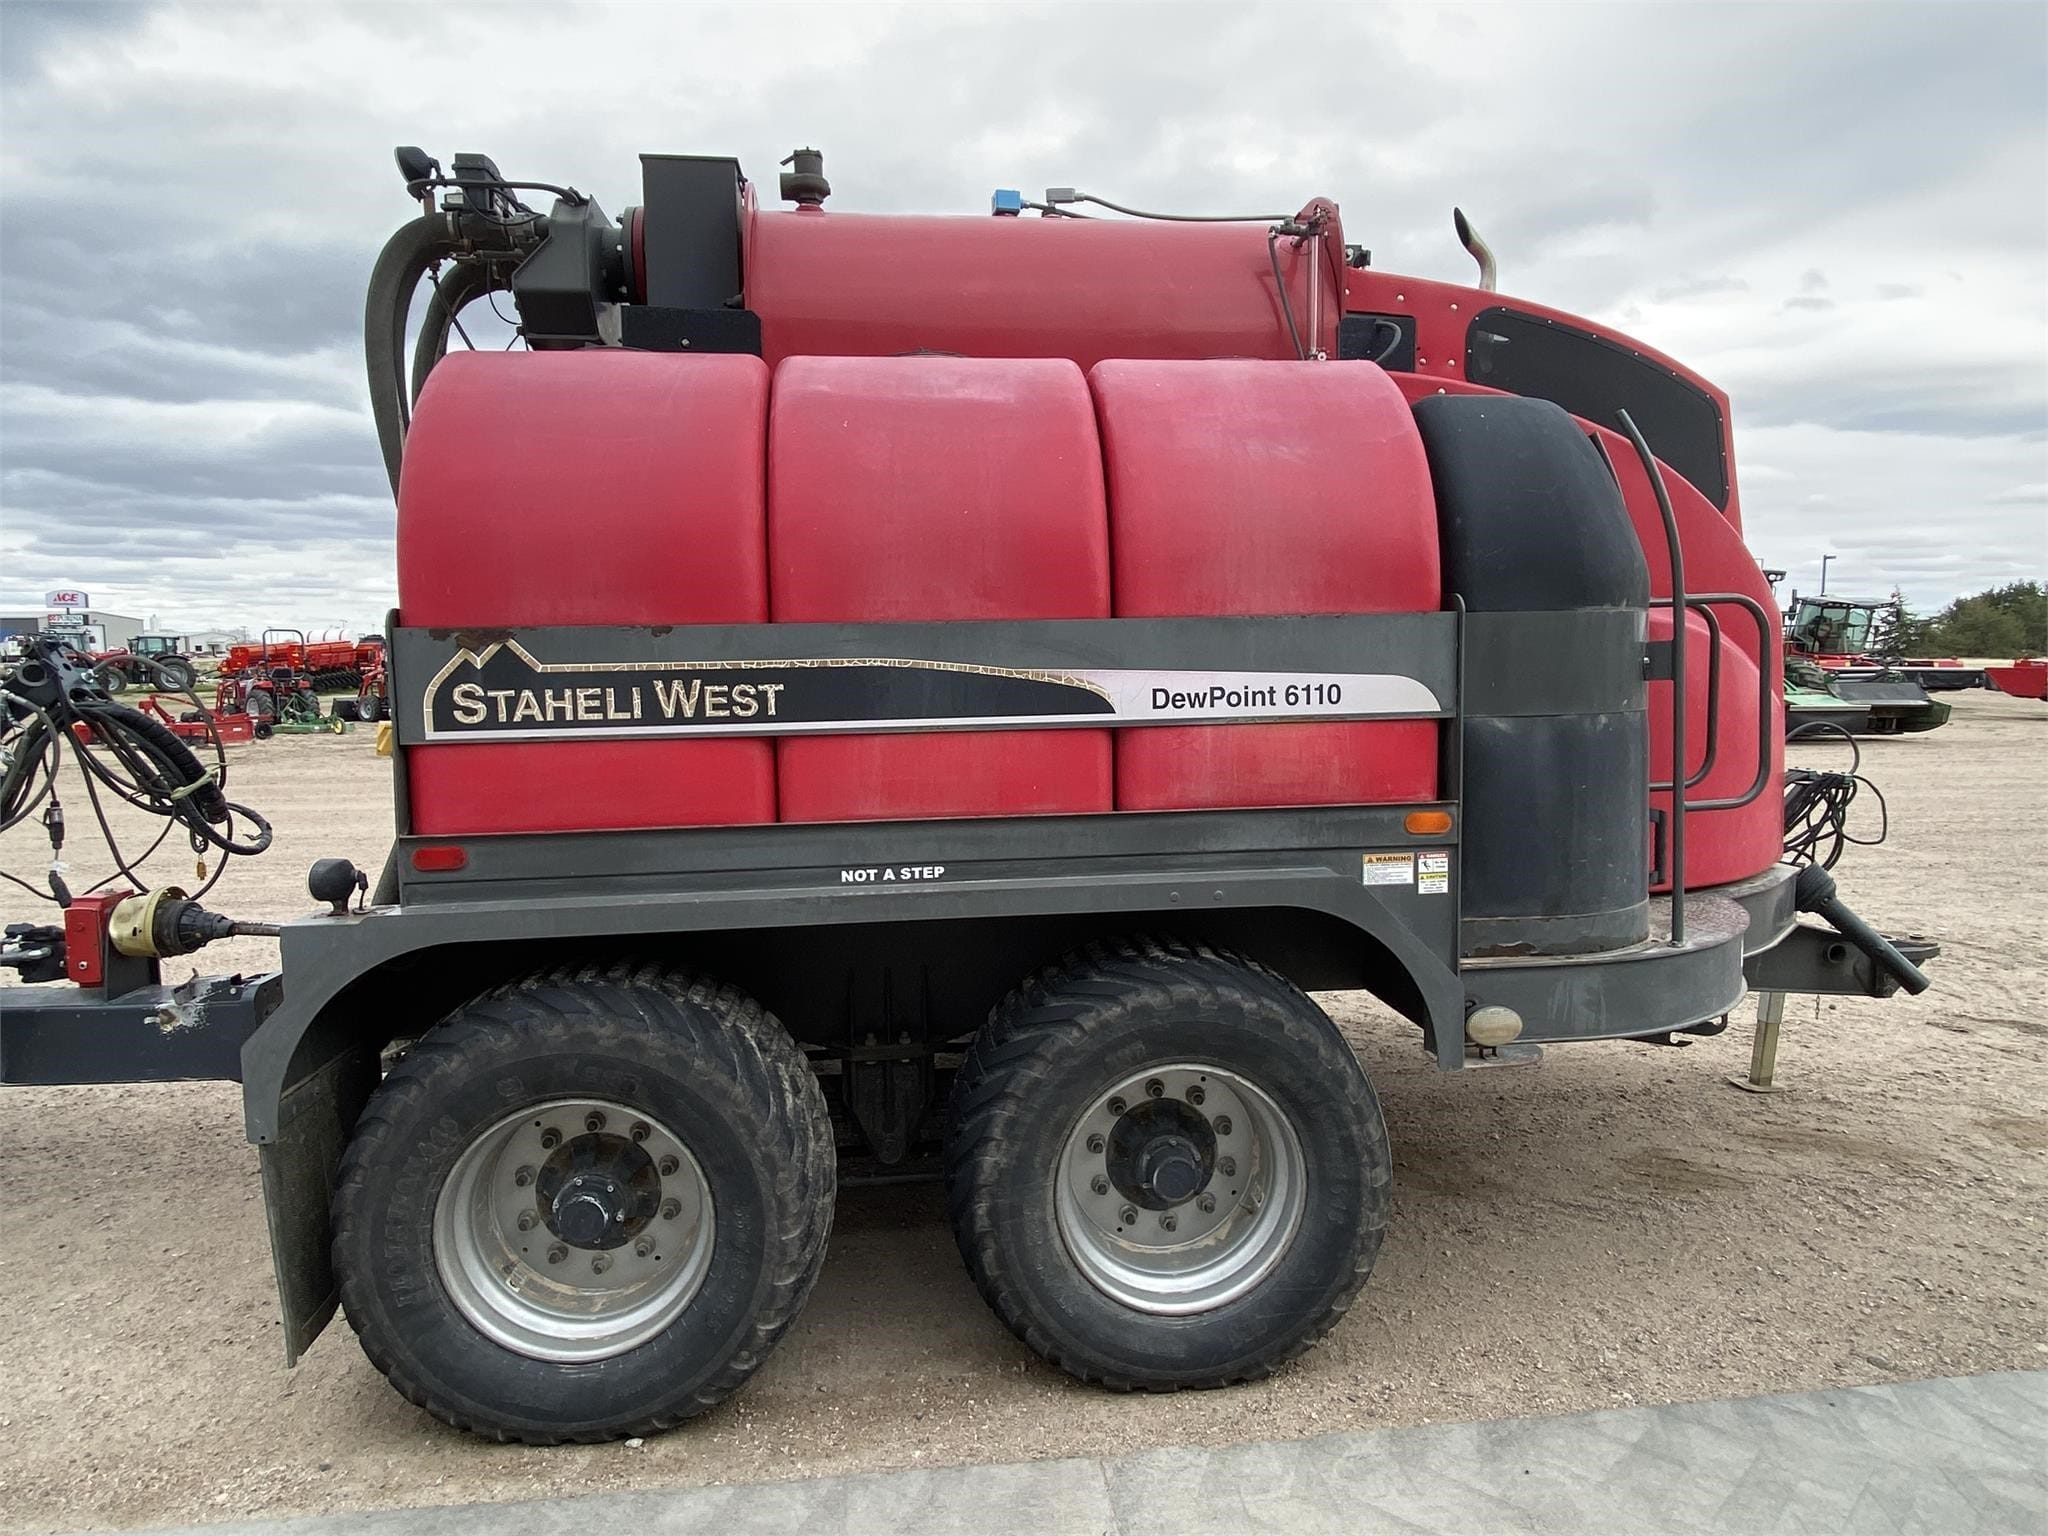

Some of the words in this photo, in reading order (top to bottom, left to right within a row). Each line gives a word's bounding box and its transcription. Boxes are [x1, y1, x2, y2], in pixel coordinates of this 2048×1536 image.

[52, 593, 79, 602] ACE
[452, 682, 642, 723] STAHELI
[653, 679, 784, 718] WEST
[1151, 686, 1276, 710] DewPoint
[1284, 683, 1342, 706] 6110
[1375, 855, 1412, 863] WARNING
[841, 869, 878, 883] NOT
[883, 868, 896, 881] A
[900, 866, 945, 880] STEP
